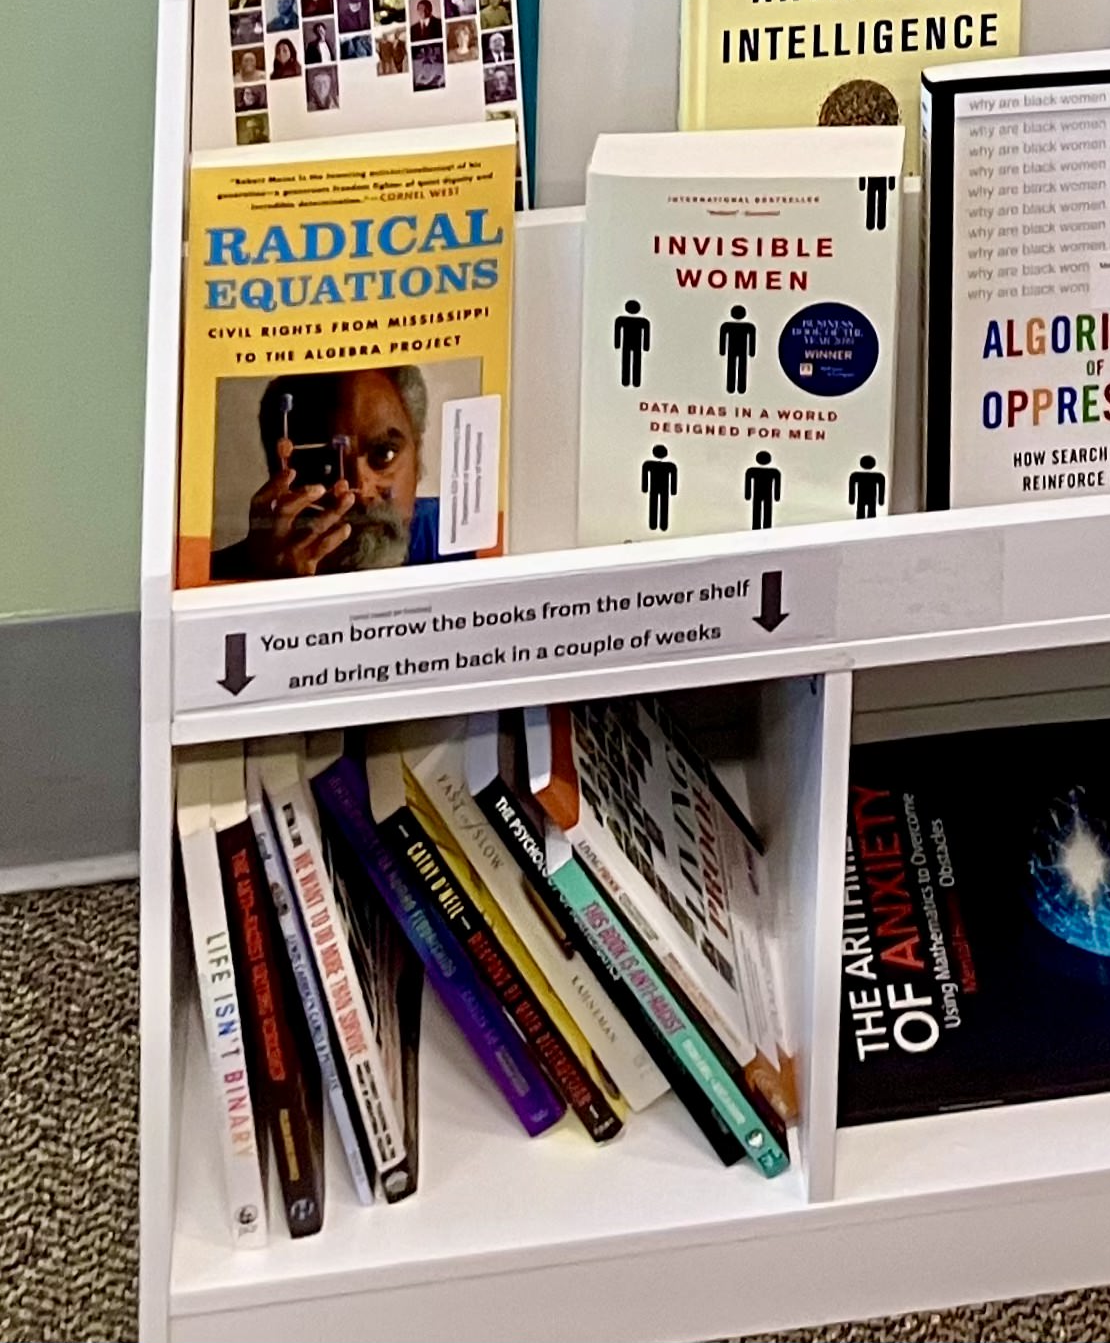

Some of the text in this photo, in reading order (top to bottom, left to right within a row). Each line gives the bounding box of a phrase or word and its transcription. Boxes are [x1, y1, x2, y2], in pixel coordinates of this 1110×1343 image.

[721, 12, 998, 64] INTELLIGENCE
[204, 208, 503, 266] RADICAL
[653, 235, 834, 258] INVISIBLE
[204, 258, 498, 313] EQUATIONS
[676, 268, 809, 292] WOMEN
[1086, 359, 1104, 376] OF
[638, 400, 838, 422] DATA BIAS IN A WORLD
[649, 420, 825, 441] DESIGNED FOR MEN
[1012, 450, 1046, 468] HOW
[1051, 446, 1108, 465] SEARCH
[1022, 470, 1103, 491] REINFORCE
[259, 581, 750, 652] You can borrow the books from the lower shelf
